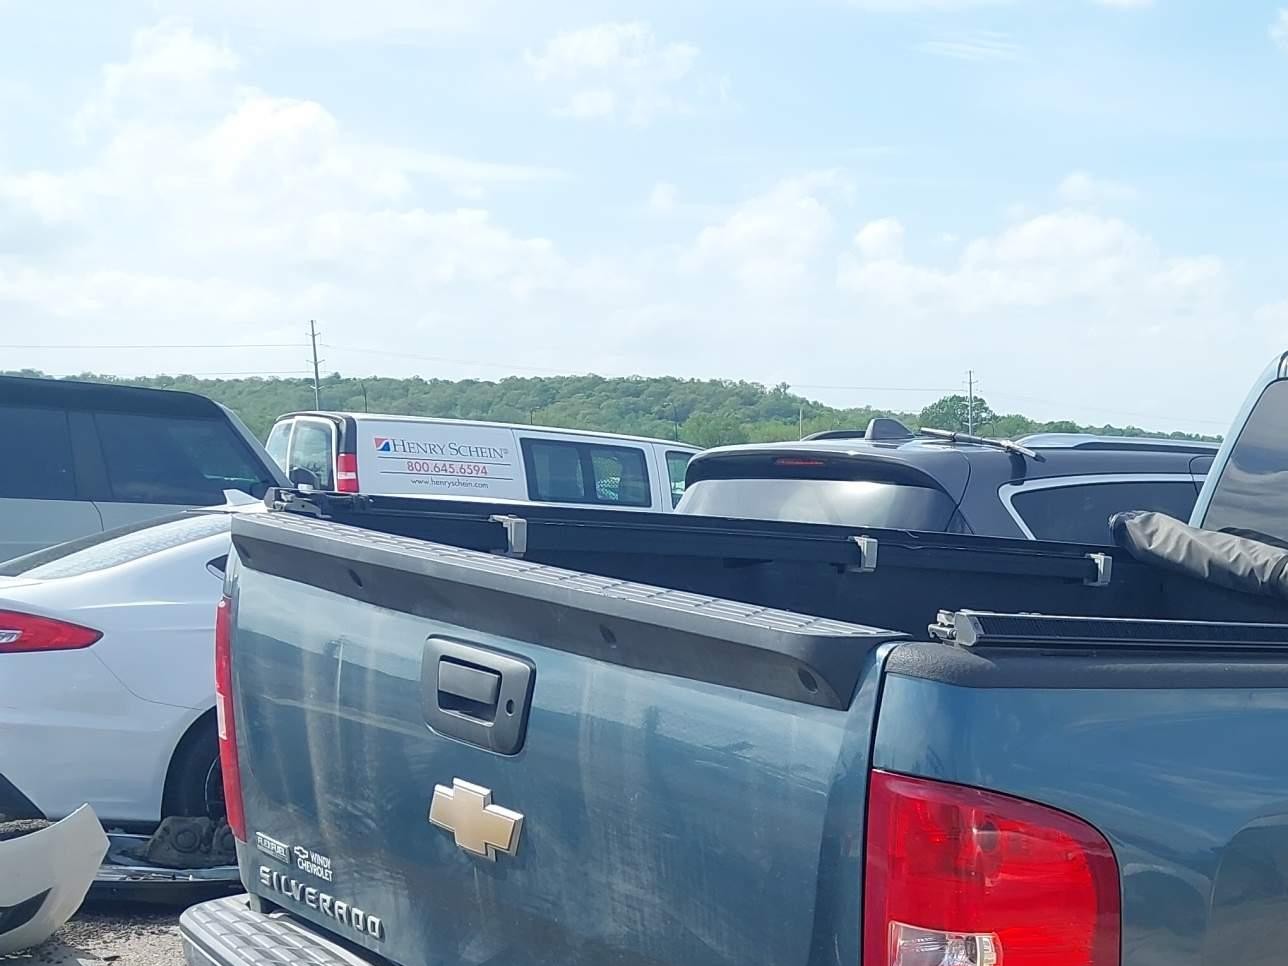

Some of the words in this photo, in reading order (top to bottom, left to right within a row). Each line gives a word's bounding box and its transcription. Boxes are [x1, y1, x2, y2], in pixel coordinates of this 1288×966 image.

[391, 438, 445, 455] HENRY
[407, 461, 488, 475] 800.645.6594
[411, 477, 489, 489] www.henryschein.com
[310, 850, 331, 869] WINDY
[297, 858, 333, 882] CHEVROLET
[259, 865, 383, 940] SILVERADO
